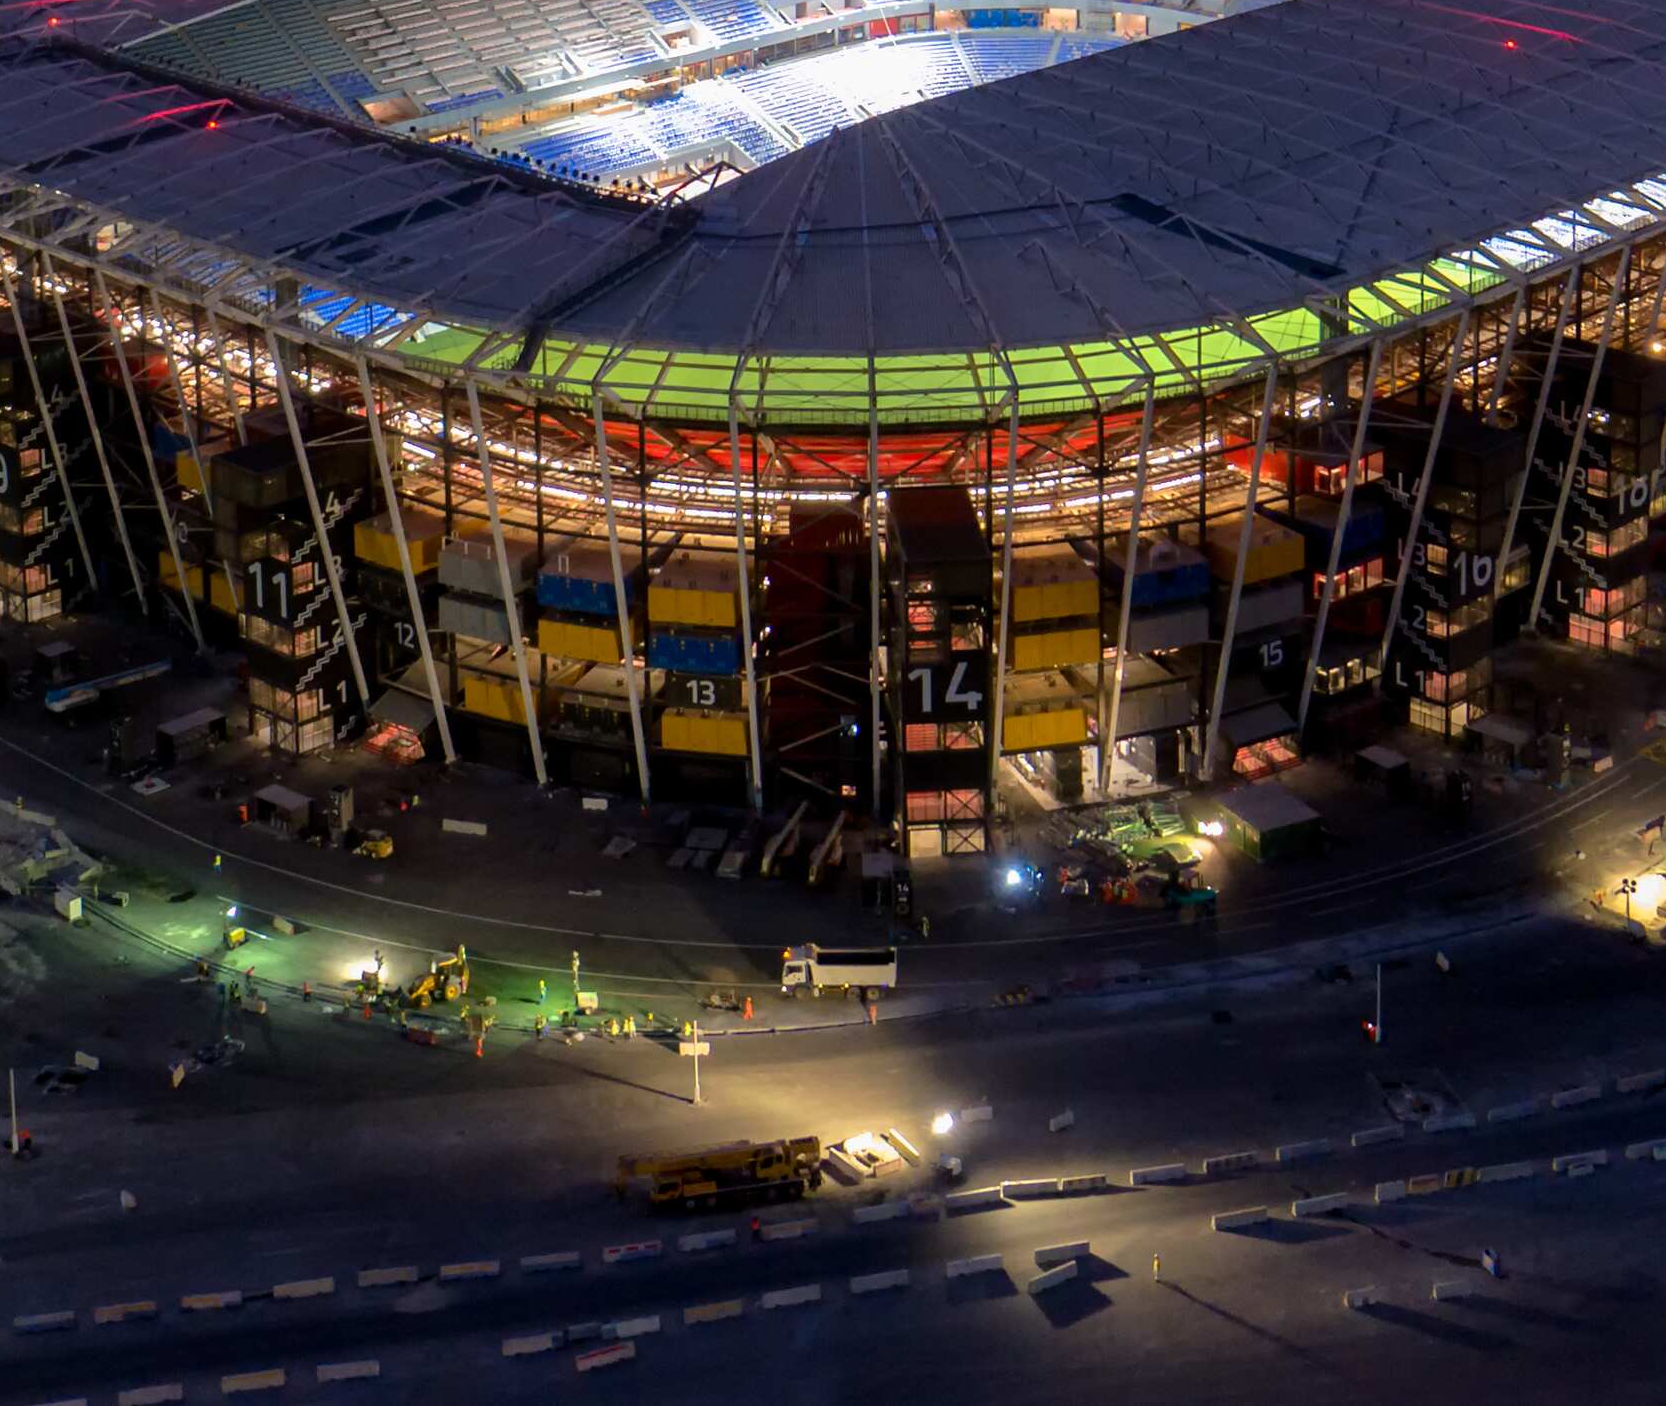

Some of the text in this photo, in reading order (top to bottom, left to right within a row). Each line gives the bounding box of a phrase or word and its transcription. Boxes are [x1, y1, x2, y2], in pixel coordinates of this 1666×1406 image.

[247, 561, 289, 619] 11
[393, 621, 416, 649] 12
[1258, 639, 1284, 667] 15
[685, 678, 717, 706] 13
[907, 660, 984, 713] 14
